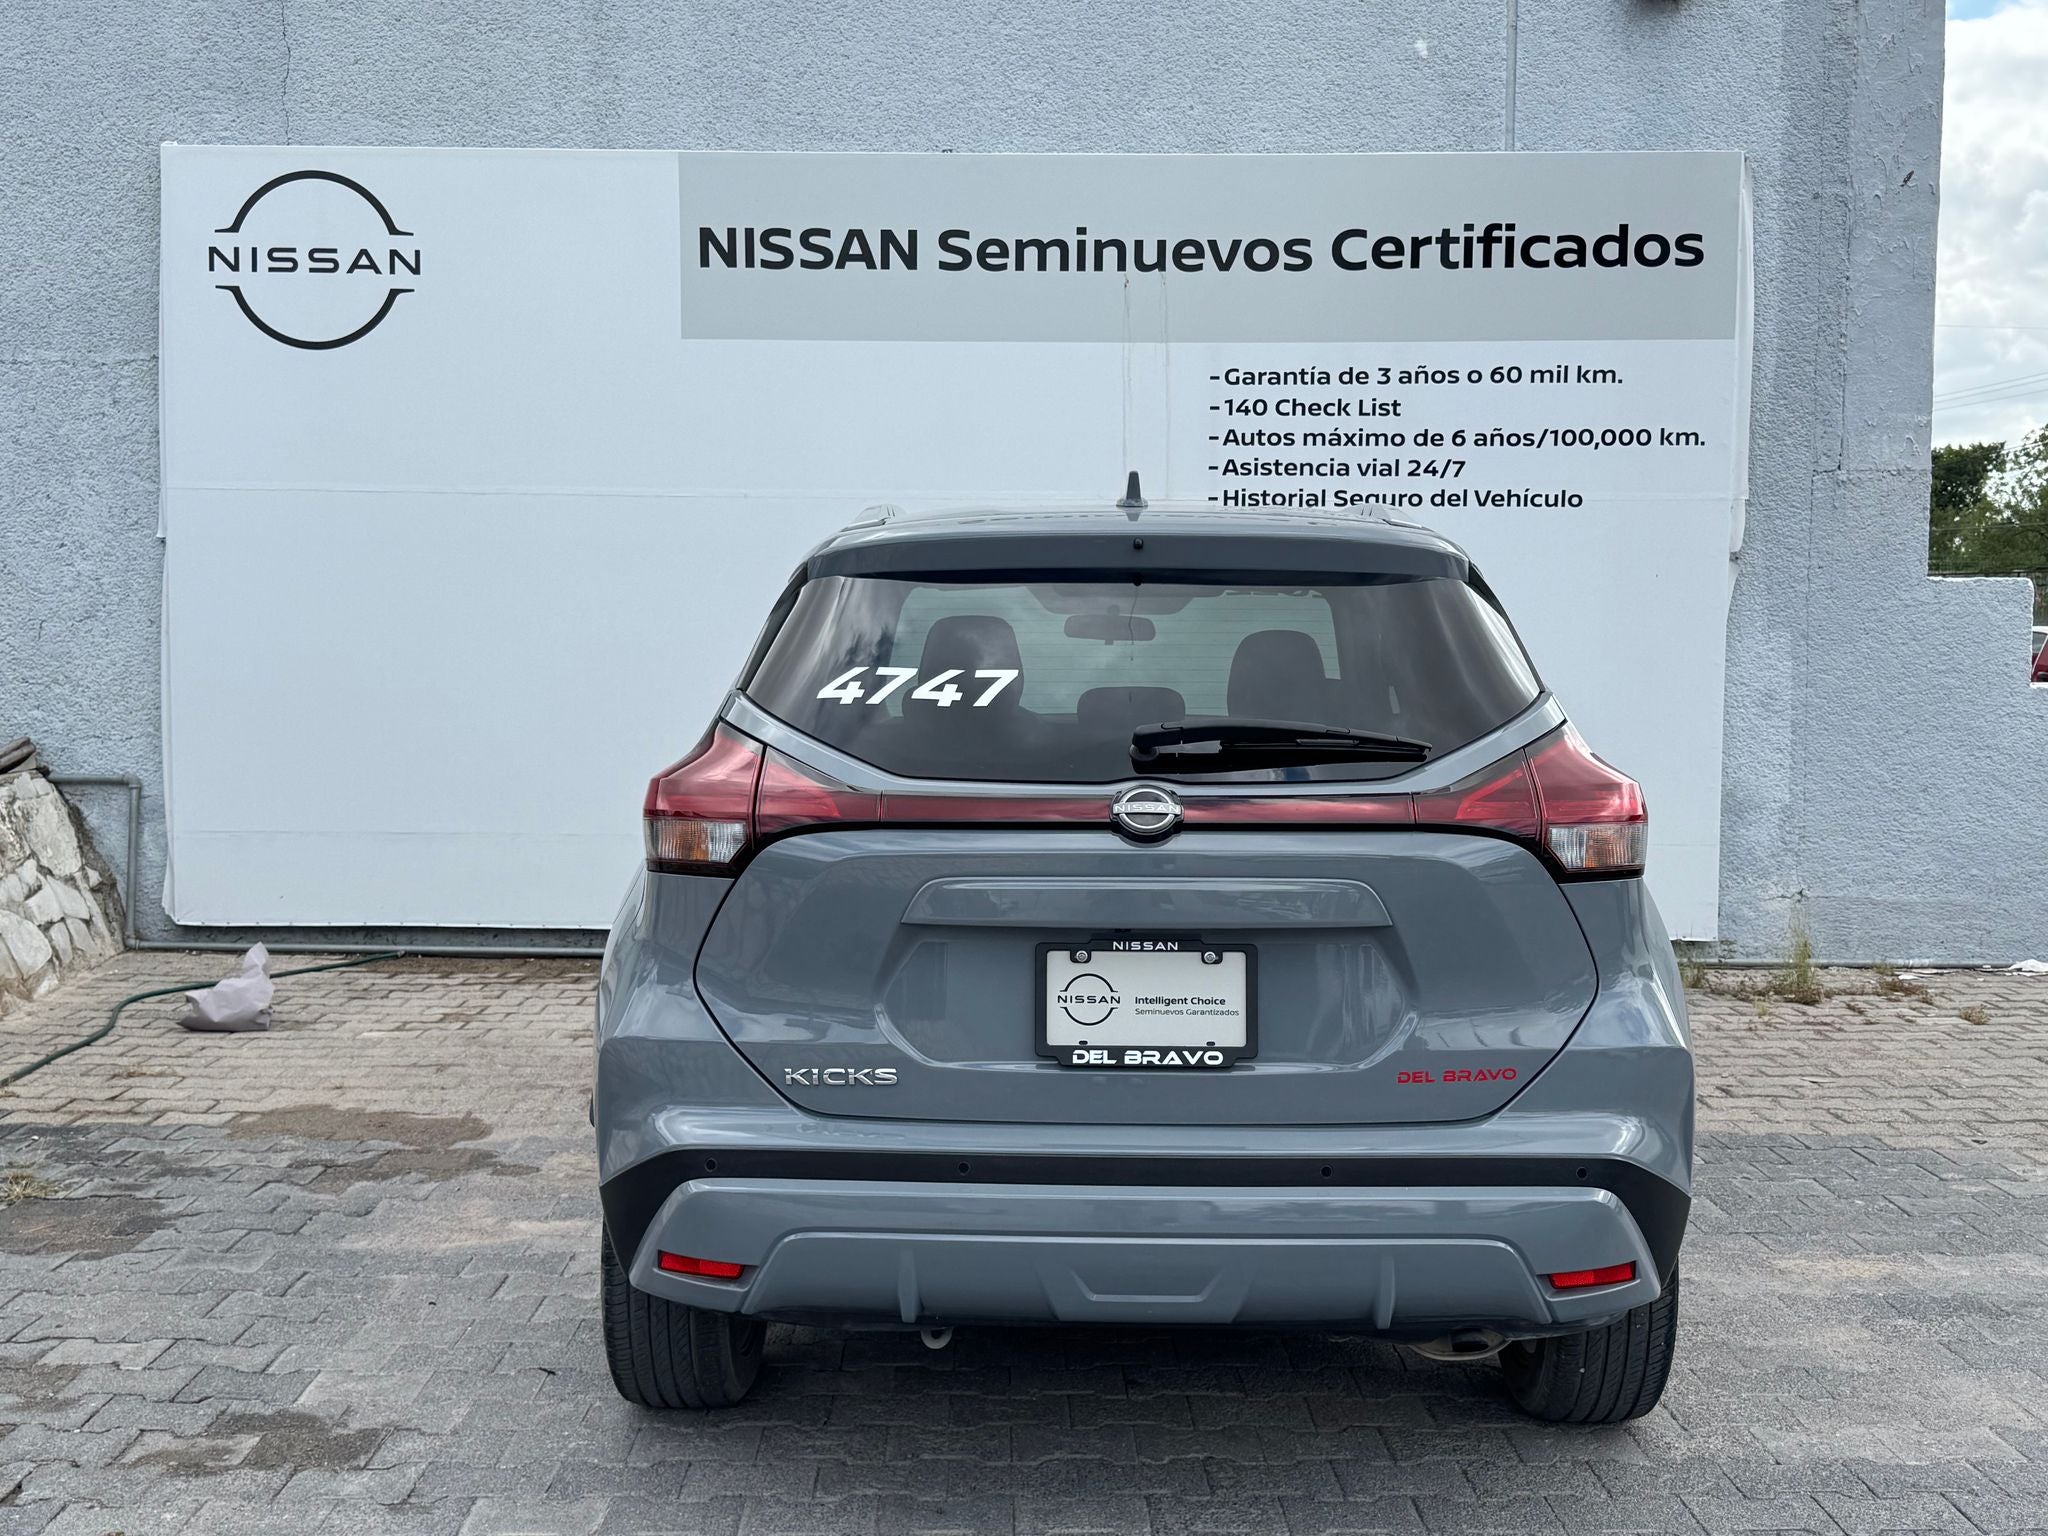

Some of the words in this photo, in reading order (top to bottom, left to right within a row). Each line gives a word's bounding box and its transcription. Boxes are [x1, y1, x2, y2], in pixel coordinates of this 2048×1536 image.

[700, 227, 917, 270] NISSAN
[939, 227, 1312, 273] Seminuevos
[1332, 223, 1705, 271] Certificados
[208, 246, 421, 276] NISSAN
[1339, 366, 1370, 385] de
[1377, 367, 1392, 385] 3
[1399, 364, 1460, 385] años
[1467, 369, 1483, 384] o
[1490, 366, 1523, 384] 60
[1530, 364, 1569, 384] mil
[1577, 365, 1623, 384] km.
[1275, 398, 1351, 417] Check
[1359, 397, 1402, 417] List
[1303, 427, 1406, 447] máximo
[1414, 428, 1445, 447] de
[1451, 429, 1467, 447] 6
[1473, 427, 1652, 450] años/100,000
[1659, 428, 1706, 447] km.
[1357, 457, 1400, 477] vial
[1407, 458, 1466, 479] 24/7
[1430, 488, 1468, 508] del
[1474, 488, 1583, 508] Vehículo
[816, 666, 1019, 707] 4747
[1114, 803, 1179, 813] NISSAN
[1112, 941, 1179, 951] NISSAN
[1057, 995, 1121, 1005] NISSAN
[1135, 996, 1188, 1008] Intelligent
[1190, 996, 1226, 1006] Choice
[1135, 1008, 1184, 1016] Seminuevos
[1186, 1008, 1240, 1017] Garantizados
[1072, 1050, 1118, 1065] DEL
[1124, 1050, 1224, 1066] BRAVO
[784, 1068, 898, 1086] KICKS
[1397, 1071, 1435, 1084] DEL
[1442, 1068, 1517, 1083] BRAVO
